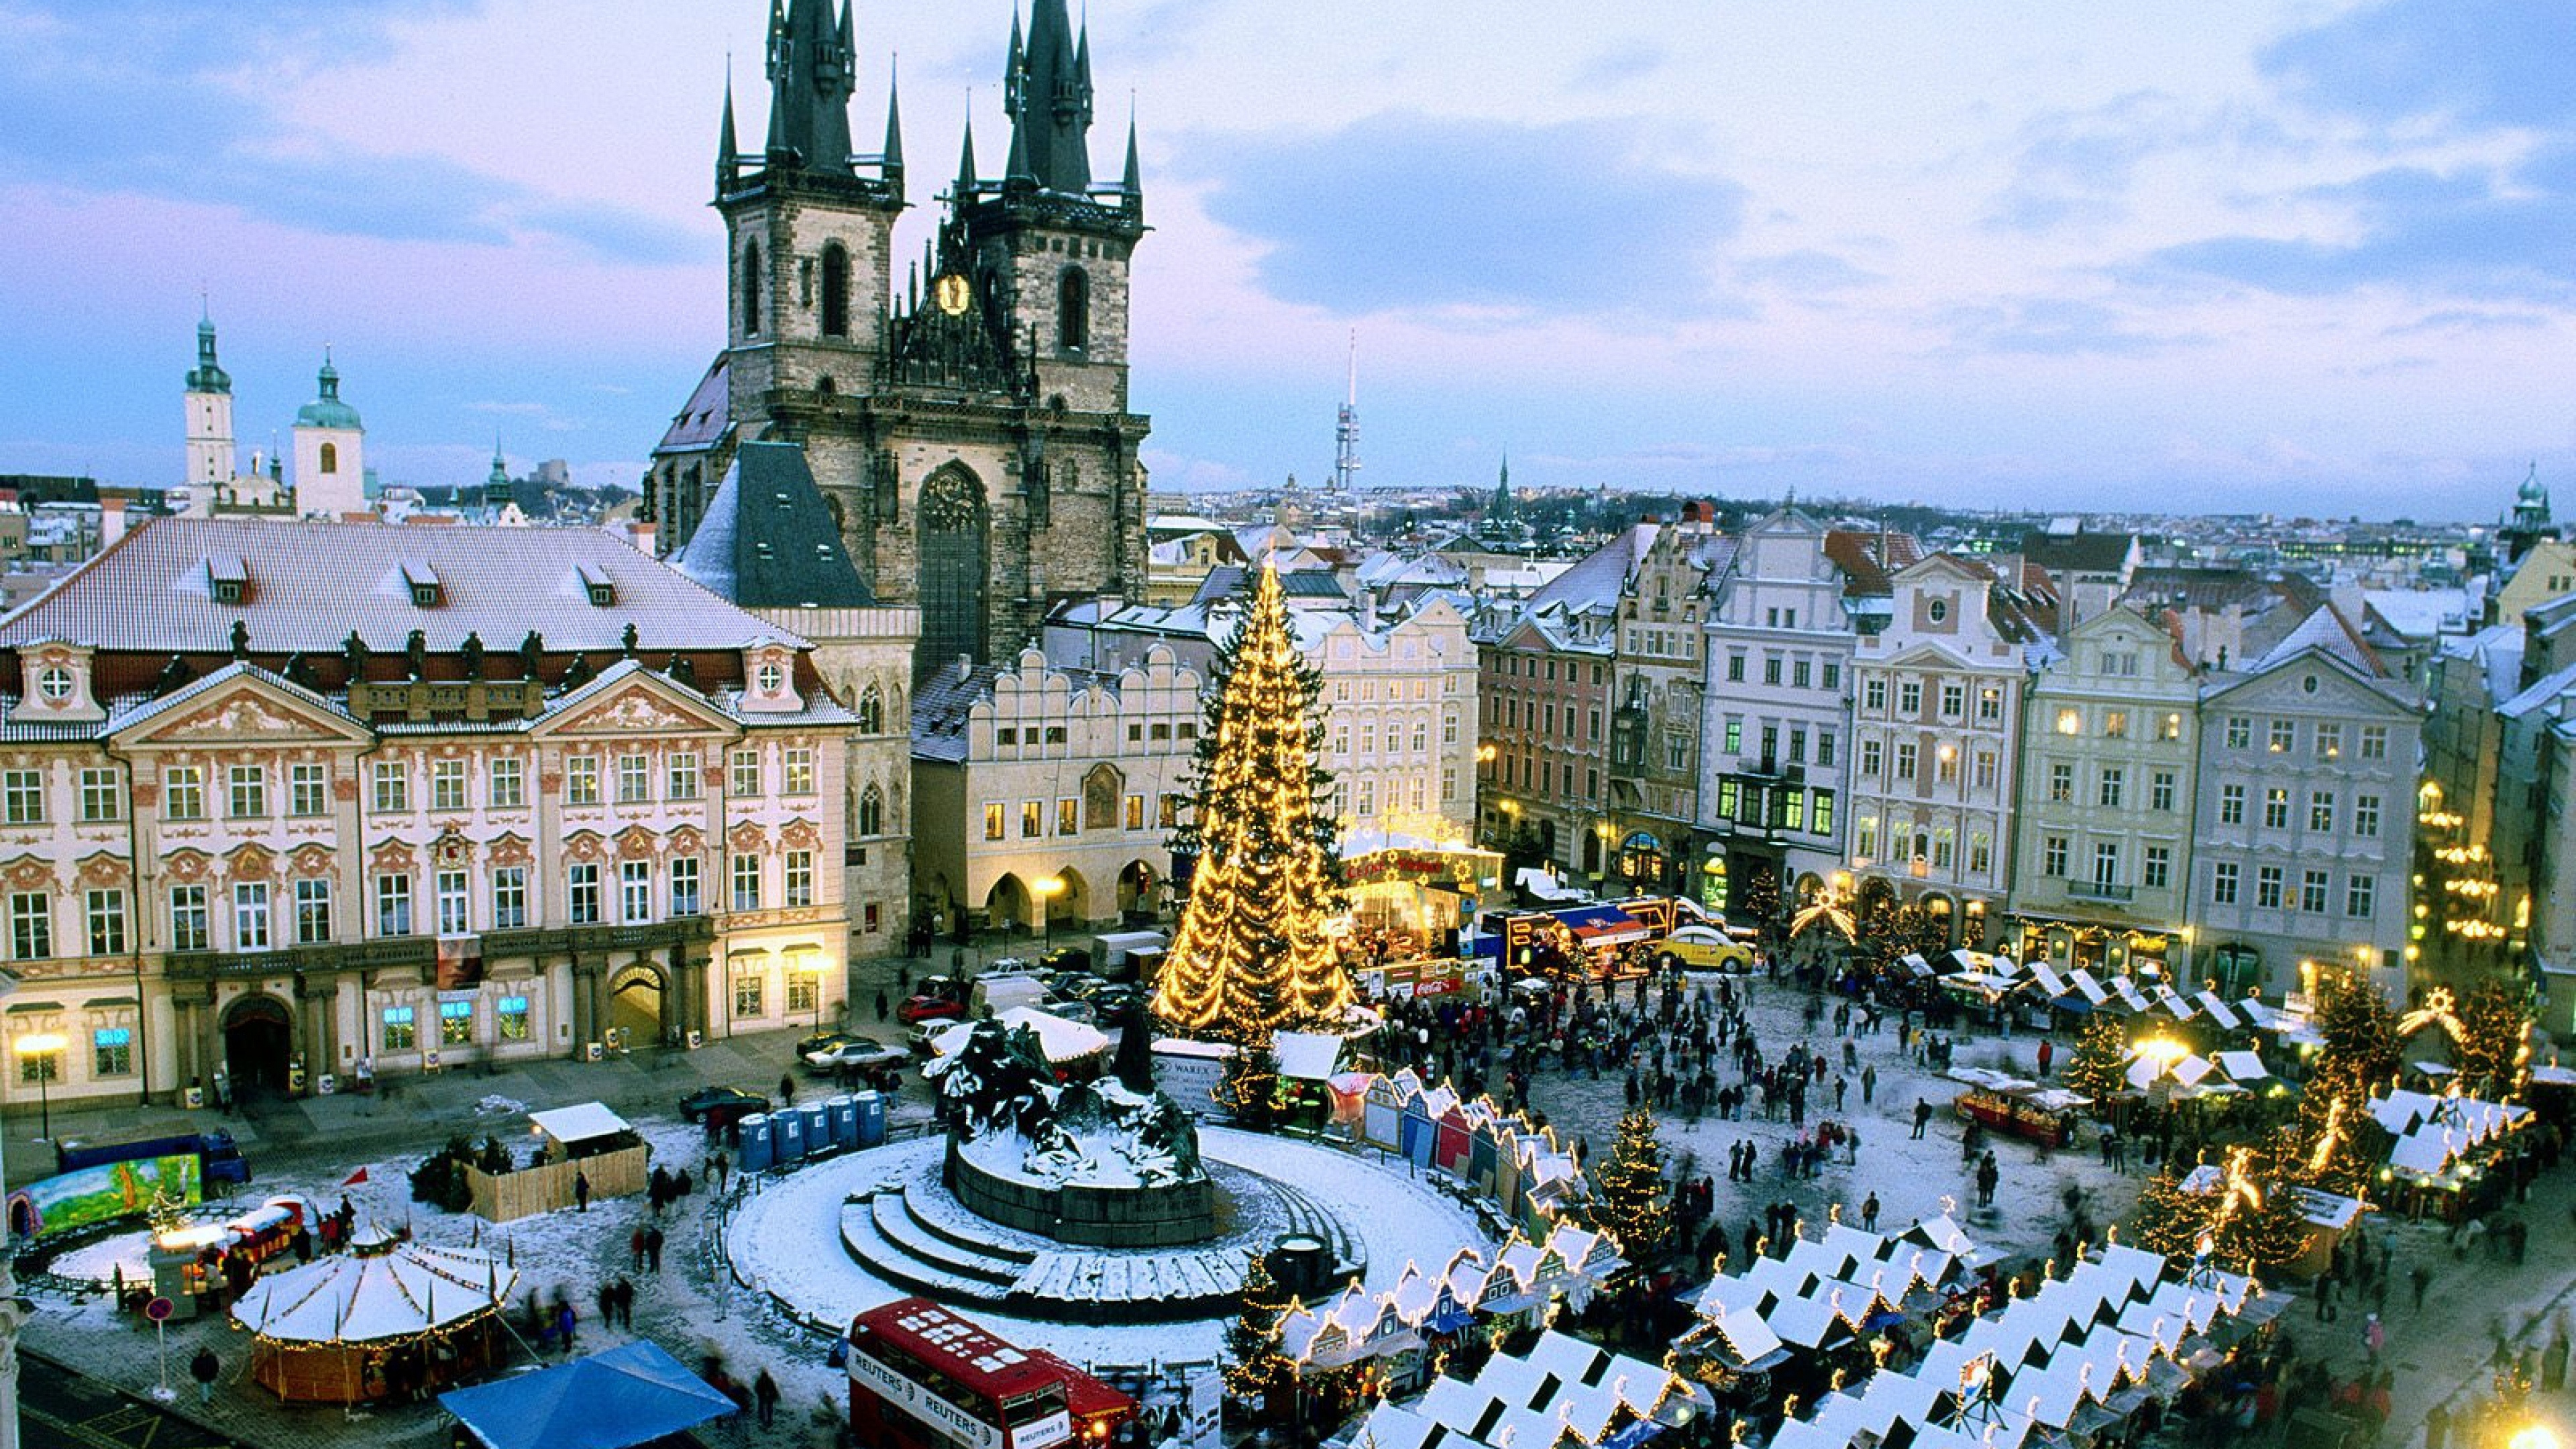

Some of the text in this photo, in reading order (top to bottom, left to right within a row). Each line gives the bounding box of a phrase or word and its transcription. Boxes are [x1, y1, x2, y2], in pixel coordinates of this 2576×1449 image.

[855, 1354, 902, 1392] REUTERS
[925, 1395, 977, 1437] REUTERS
[1019, 1424, 1055, 1442] REUTERS
